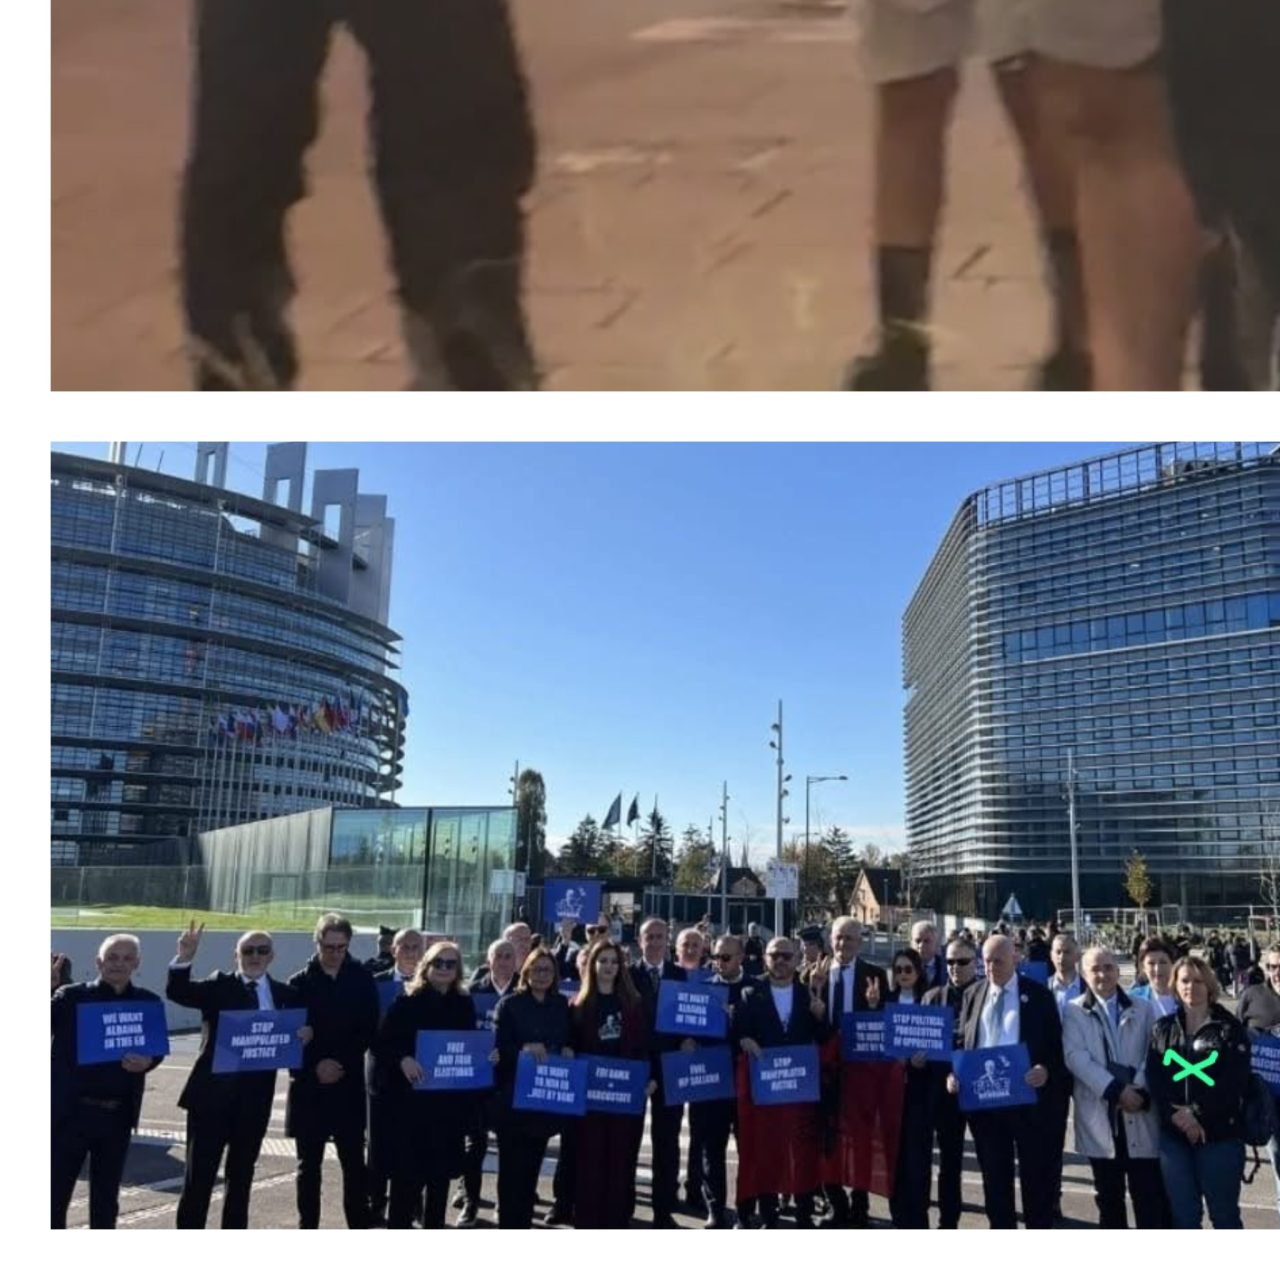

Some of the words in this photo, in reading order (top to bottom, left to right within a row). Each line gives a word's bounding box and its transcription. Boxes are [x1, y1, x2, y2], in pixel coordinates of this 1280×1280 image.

[251, 1022, 274, 1033] STOP
[231, 1033, 290, 1047] MANIPULATED
[242, 1047, 276, 1059] JUSTICE
